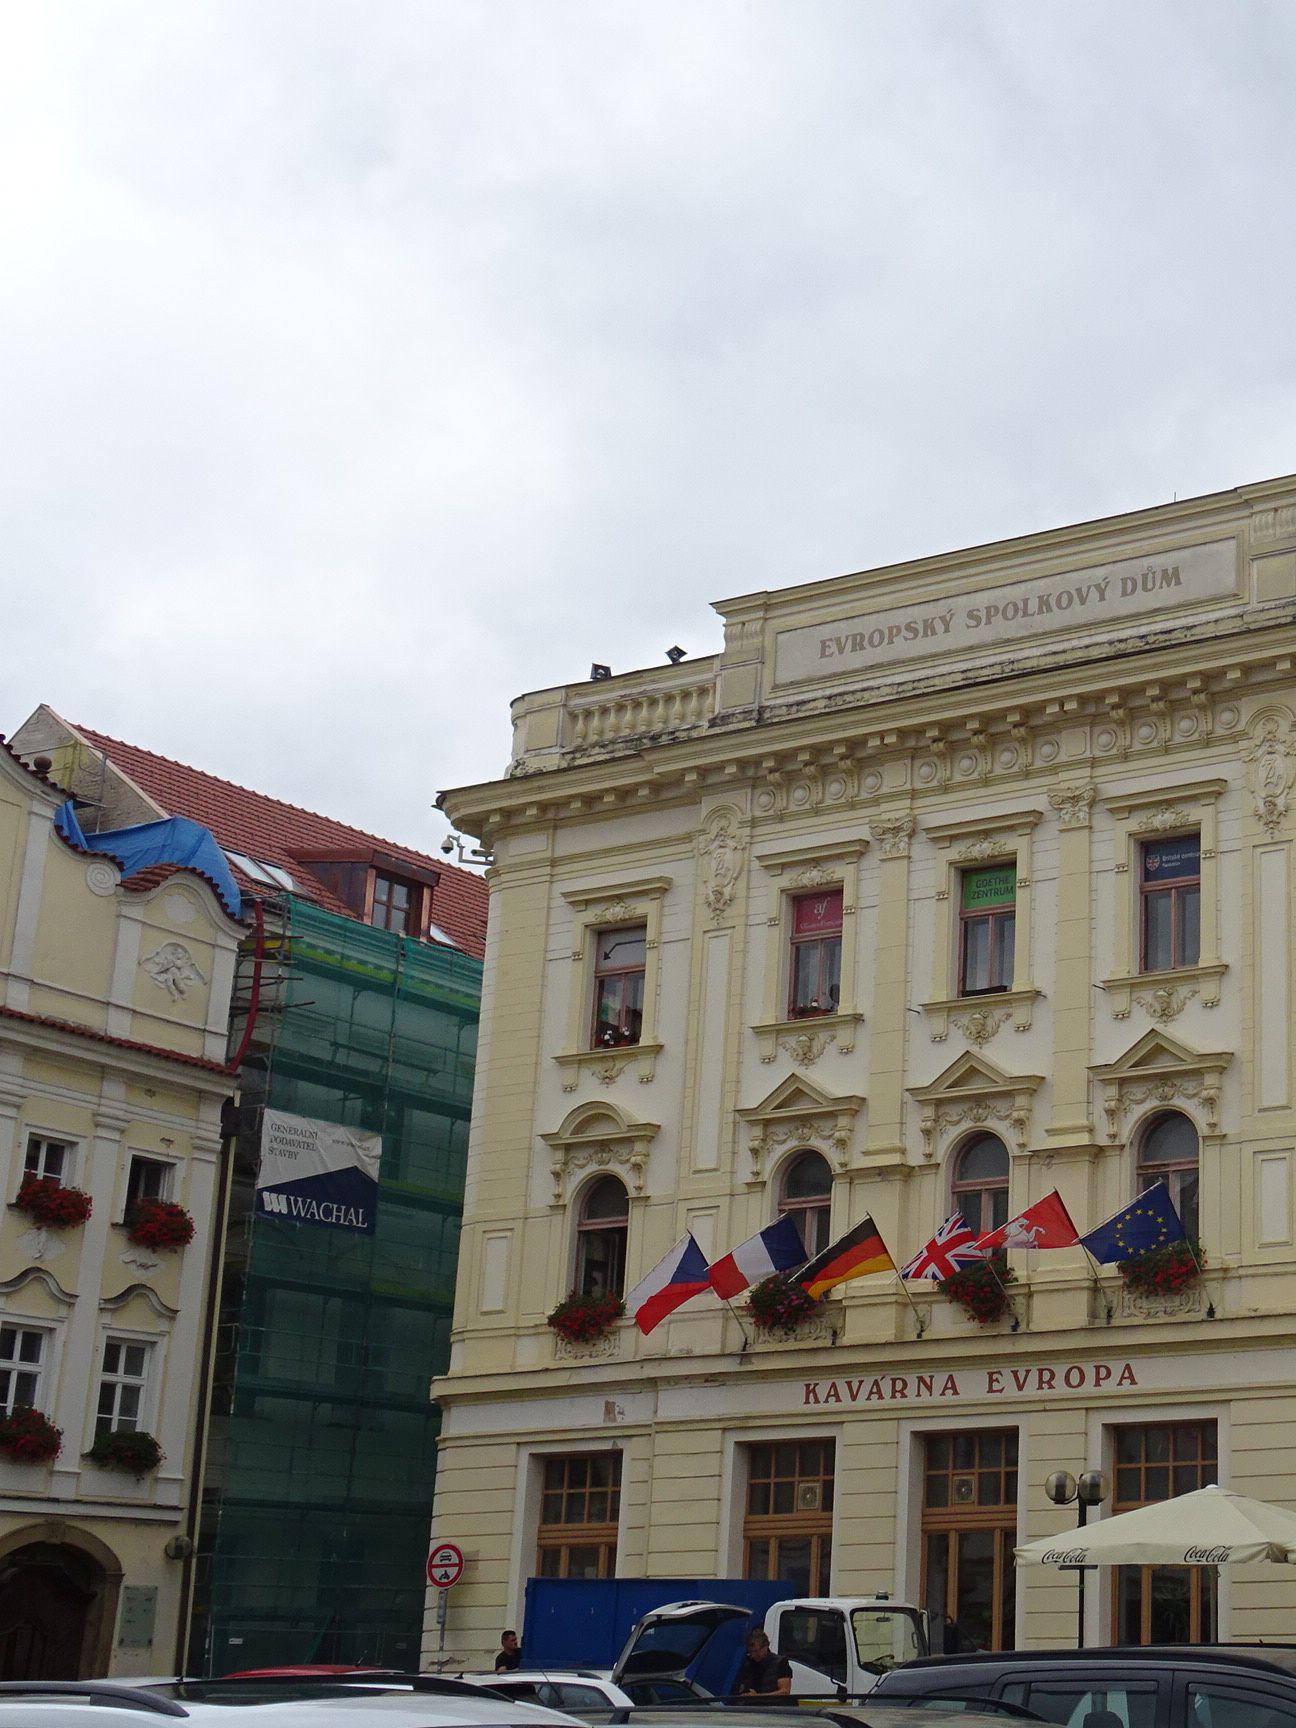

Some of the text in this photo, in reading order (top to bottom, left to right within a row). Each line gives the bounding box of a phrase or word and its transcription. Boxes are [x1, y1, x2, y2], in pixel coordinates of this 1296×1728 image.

[819, 565, 1183, 659] EVROPSKÝ SPOLKOVÝ DŮM
[971, 886, 1014, 900] ZENTRUM
[976, 876, 1009, 889] GOETHE
[288, 1196, 368, 1228] WACHAL
[803, 1363, 1138, 1405] KAVÁRNA EVROPA
